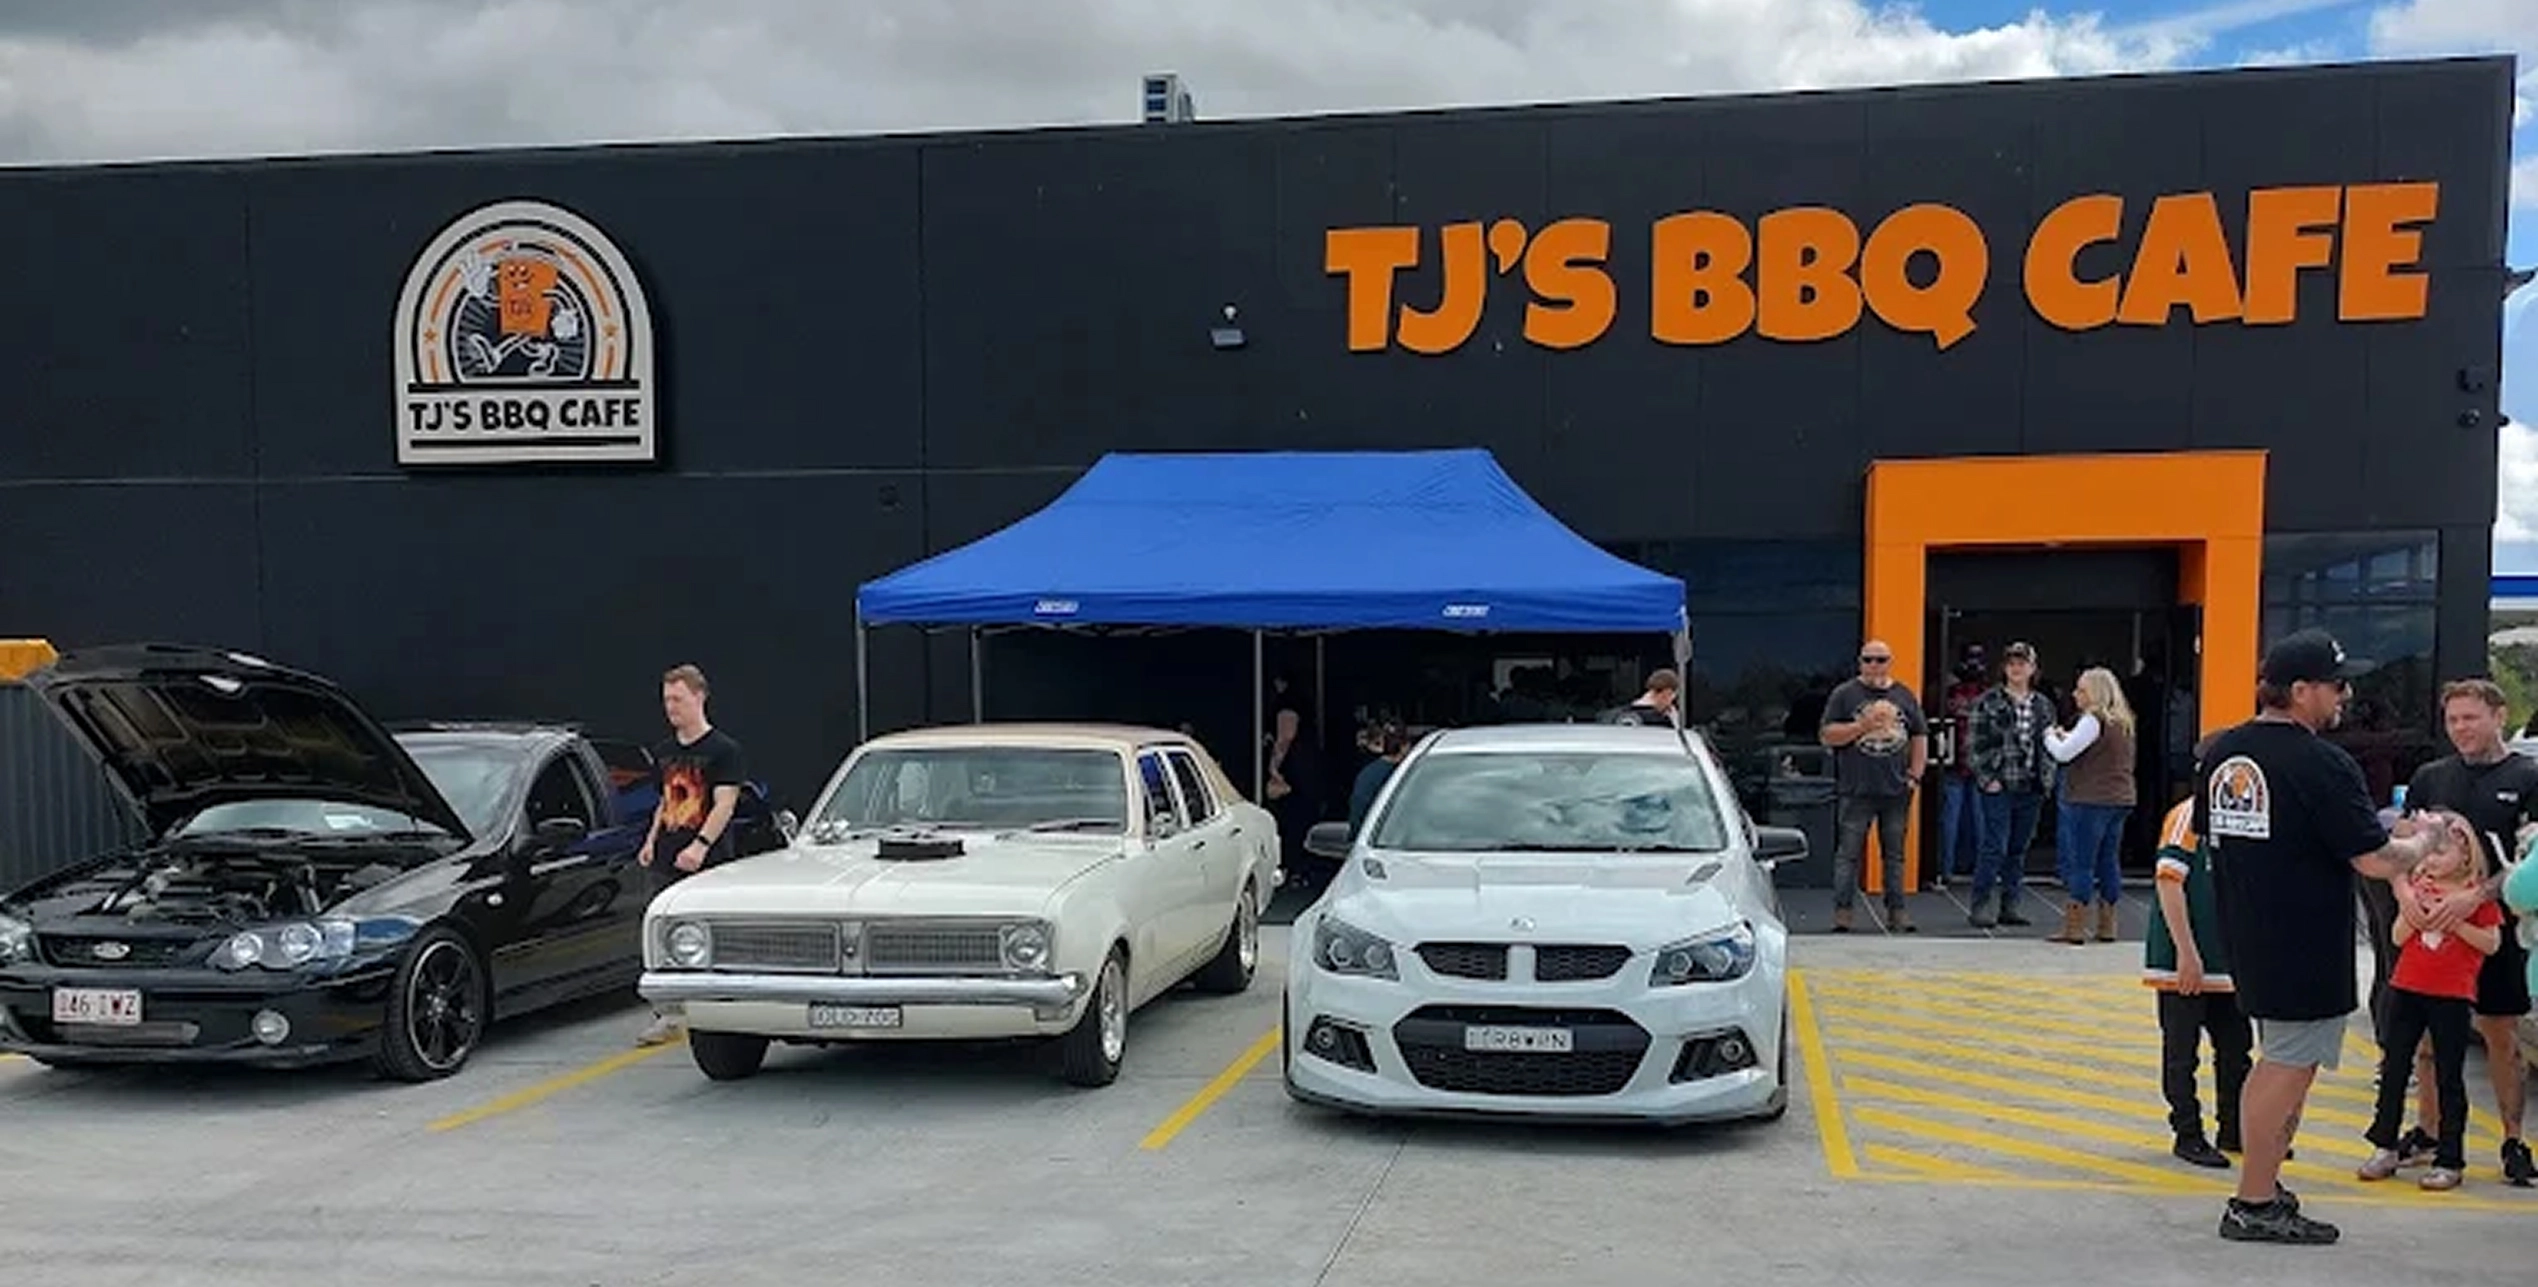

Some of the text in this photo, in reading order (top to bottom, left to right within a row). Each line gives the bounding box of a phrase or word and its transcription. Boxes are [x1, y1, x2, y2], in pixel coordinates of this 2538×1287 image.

[1325, 182, 2439, 355] TJ'S BBQ CAFE
[408, 398, 641, 431] TJ'S BBQ CAFE
